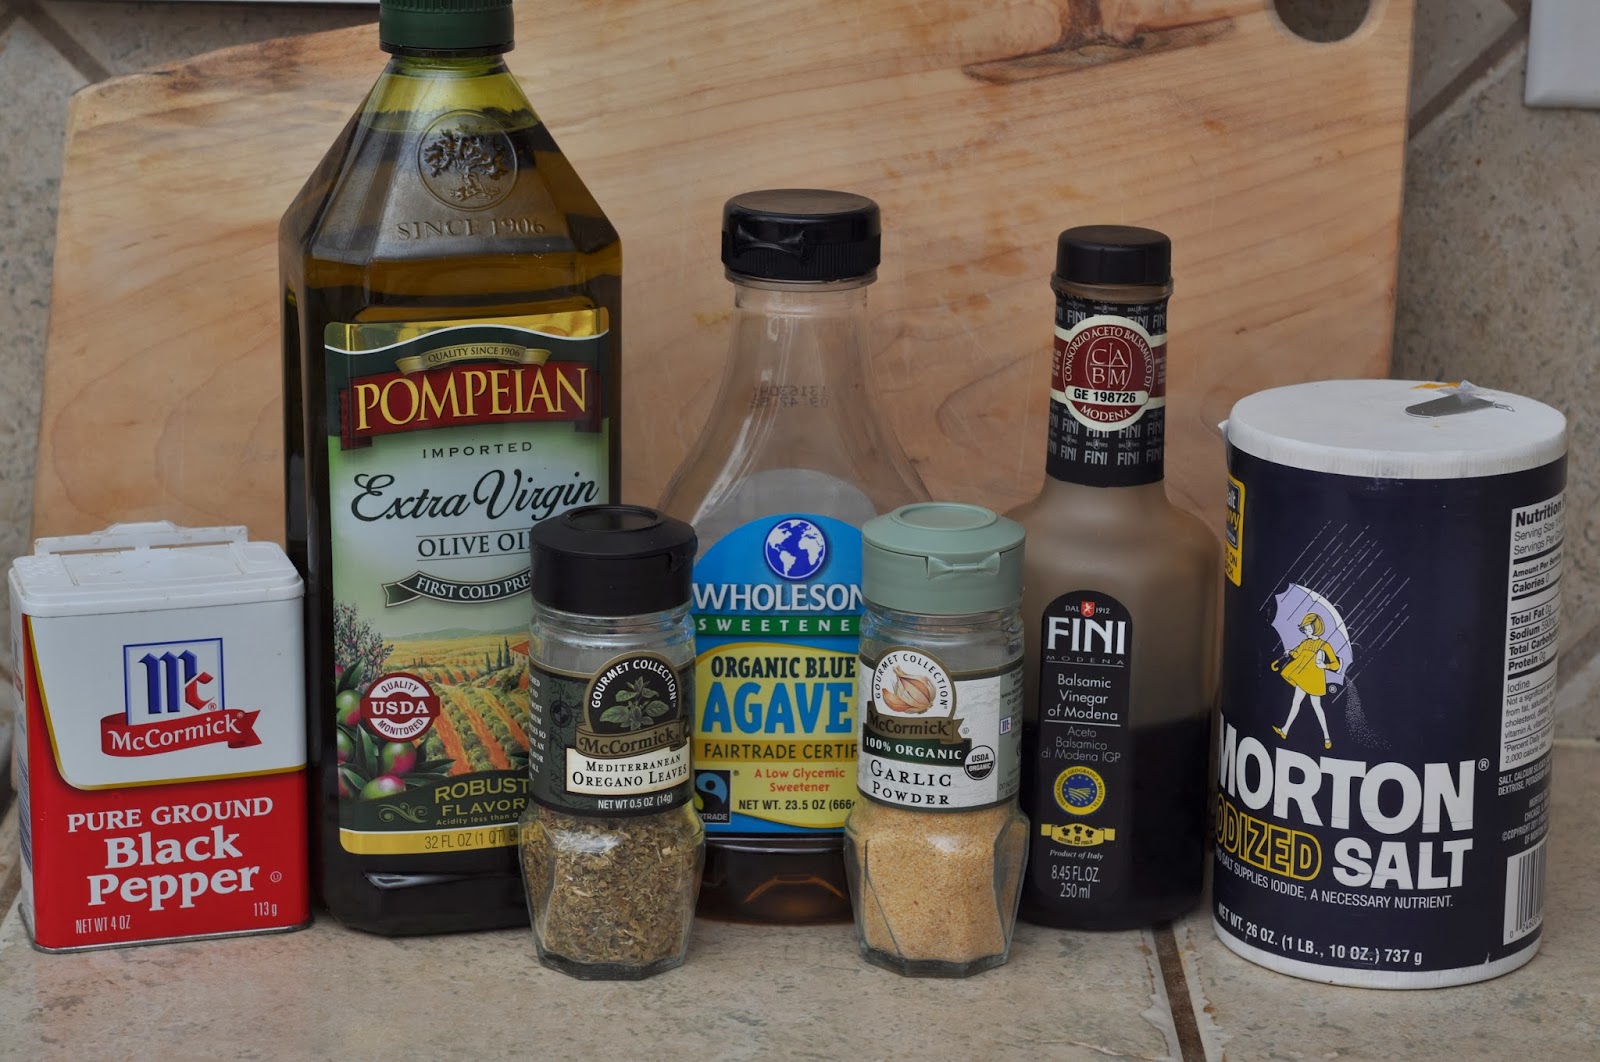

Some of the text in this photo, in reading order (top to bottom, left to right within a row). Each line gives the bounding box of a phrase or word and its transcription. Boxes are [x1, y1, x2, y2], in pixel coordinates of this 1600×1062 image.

[396, 217, 545, 240] SINCE 1906
[1067, 310, 1086, 324] FINI
[427, 345, 520, 364] QUALITY SINCE 1906
[1065, 332, 1090, 381] CONSORZIO
[1092, 327, 1123, 338] ACETO
[1124, 330, 1152, 373] BALSAMICO
[354, 367, 588, 430] POMPEIAN
[1074, 389, 1136, 403] GE 198726
[1081, 405, 1131, 421] MODENA
[1062, 418, 1079, 434] FINI
[423, 441, 532, 458] IMPORTED
[1061, 445, 1077, 461] FINI
[1084, 450, 1107, 465] FINI
[1117, 452, 1139, 465] FINI
[351, 468, 599, 522] Extra Virgin
[1516, 501, 1561, 527] Nutrition
[1514, 527, 1542, 541] Serving
[418, 535, 489, 557] OLIVE
[1513, 540, 1545, 555] Servings
[1512, 561, 1549, 578] Amount Per
[416, 576, 457, 598] FIRST
[459, 583, 501, 599] COLD
[1512, 577, 1545, 594] Calories
[698, 619, 850, 631] SWEETENE
[1510, 608, 1545, 626] Total Fat
[1047, 616, 1126, 655] FINI
[1509, 625, 1540, 641] Sodium
[1509, 642, 1529, 656] Total
[711, 656, 856, 678] ORGANIC BLUE
[1046, 655, 1124, 665] MODENA
[1508, 655, 1538, 671] Protein
[381, 679, 420, 693] QUALITY
[591, 659, 677, 708] GOURMET COLLECTION
[875, 654, 898, 699] GOURMET
[903, 654, 948, 706] COLLECTION
[1057, 673, 1112, 689] Balsamic
[1507, 680, 1530, 693] Iodine
[1059, 690, 1108, 707] Vinegar
[1506, 697, 1518, 706] Not
[371, 700, 429, 715] USDA
[701, 681, 853, 734] AGAVE
[1047, 703, 1118, 721] of Modena
[1506, 708, 1520, 717] from
[378, 718, 424, 735] MONITORED
[869, 711, 949, 736] McCormick
[107, 715, 241, 751] McCormick
[1067, 726, 1097, 738] Aceto
[1505, 727, 1526, 738] vitamin
[579, 727, 675, 756] McCormick
[865, 736, 962, 760] 100% ORGANIC
[1055, 736, 1108, 751] Balsamico
[704, 743, 857, 759] FAIRTRADE CERTIF
[972, 753, 989, 761] USDA
[1041, 747, 1121, 763] di Modena IGP
[1505, 752, 1522, 763] 2,000
[754, 768, 846, 780] A Low Glycemic
[969, 763, 992, 772] ORGANIC
[1218, 711, 1475, 834] MORTON
[770, 783, 830, 792] Sweetener
[1498, 774, 1513, 786] SALT,
[435, 778, 529, 804] ROBUST
[442, 798, 525, 816] FLAVOR
[598, 793, 673, 810] NET WT 0.5 OZ (14g)
[738, 800, 759, 810] NET
[762, 800, 781, 810] WT.
[785, 800, 808, 810] 23.5
[812, 800, 825, 810] OZ
[67, 797, 273, 833] PURE GROUND
[435, 817, 467, 826] Acidity
[471, 815, 487, 823] less
[104, 825, 242, 869] Black
[425, 836, 438, 849] 32
[441, 835, 454, 848] FL
[458, 833, 472, 847] OZ
[475, 833, 484, 846] (1
[489, 830, 505, 844] QT)
[1216, 793, 1473, 890] ODIZED SALT
[1049, 849, 1077, 858] Product
[1087, 852, 1103, 860] Italy
[1051, 865, 1070, 880] 8.45
[1222, 852, 1233, 871] SALT
[1234, 862, 1268, 888] SUPPLIES
[1270, 877, 1307, 900] IODIDE,
[1310, 889, 1319, 901] A
[1322, 891, 1391, 909] NECESSARY
[1394, 895, 1453, 909] NUTRIENT.
[87, 866, 259, 911] Pepper
[1060, 883, 1091, 899] 250 ml
[253, 903, 277, 917] 113 g
[75, 915, 131, 934] NET WT 4 OZ
[1219, 902, 1422, 965] NET WT. 26 OZ. (1 LB., 10 OZ.) 737 g
